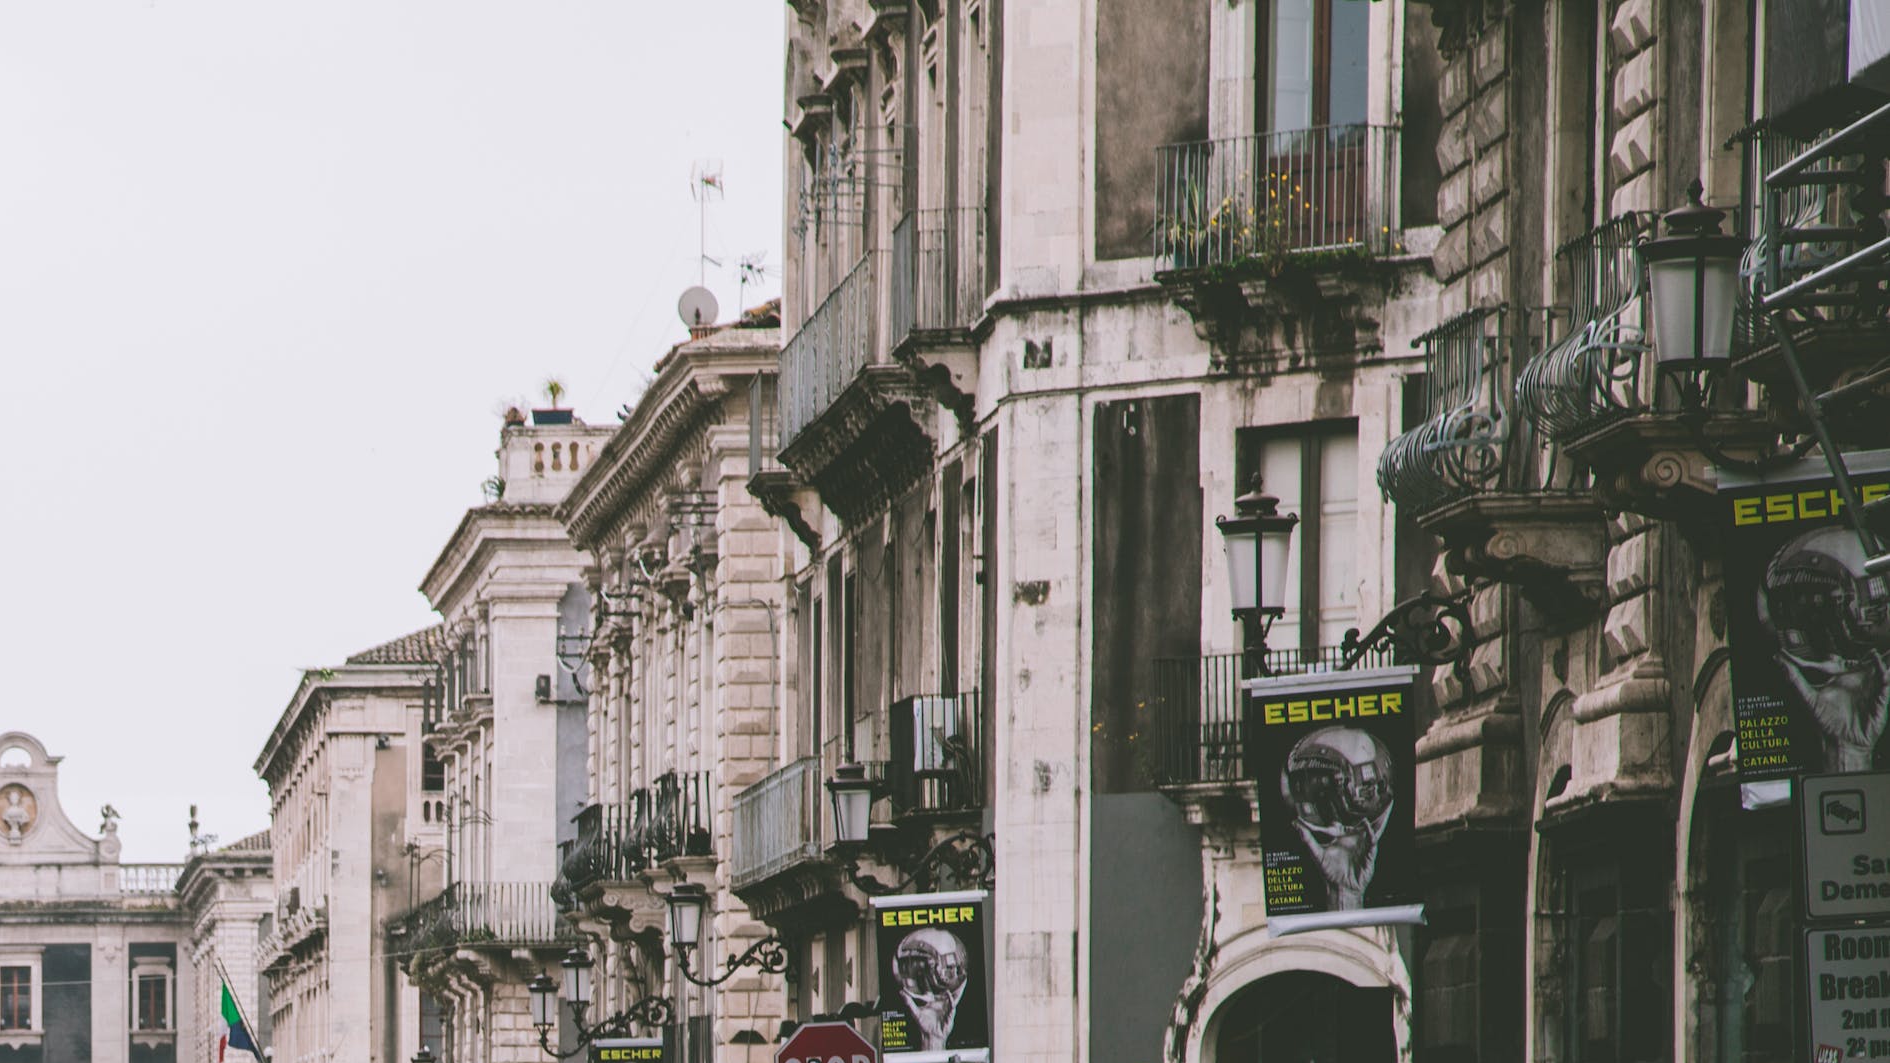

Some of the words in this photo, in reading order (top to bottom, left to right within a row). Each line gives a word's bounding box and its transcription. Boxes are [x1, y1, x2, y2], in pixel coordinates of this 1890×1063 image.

[1264, 692, 1402, 724] ESCHER
[1739, 715, 1789, 729] PALAZZO
[1740, 728, 1774, 740] DELLA
[1741, 737, 1790, 750] CULTURA
[1743, 754, 1788, 767] CATANIA
[1266, 866, 1303, 876] PALAZZO
[1267, 876, 1293, 885] DELLA
[1268, 883, 1304, 893] CULTURA
[1269, 895, 1303, 905] CATANIA
[882, 906, 974, 927] ESCHER
[1841, 1008, 1877, 1030] 2nd
[600, 1049, 662, 1061] ESCHER
